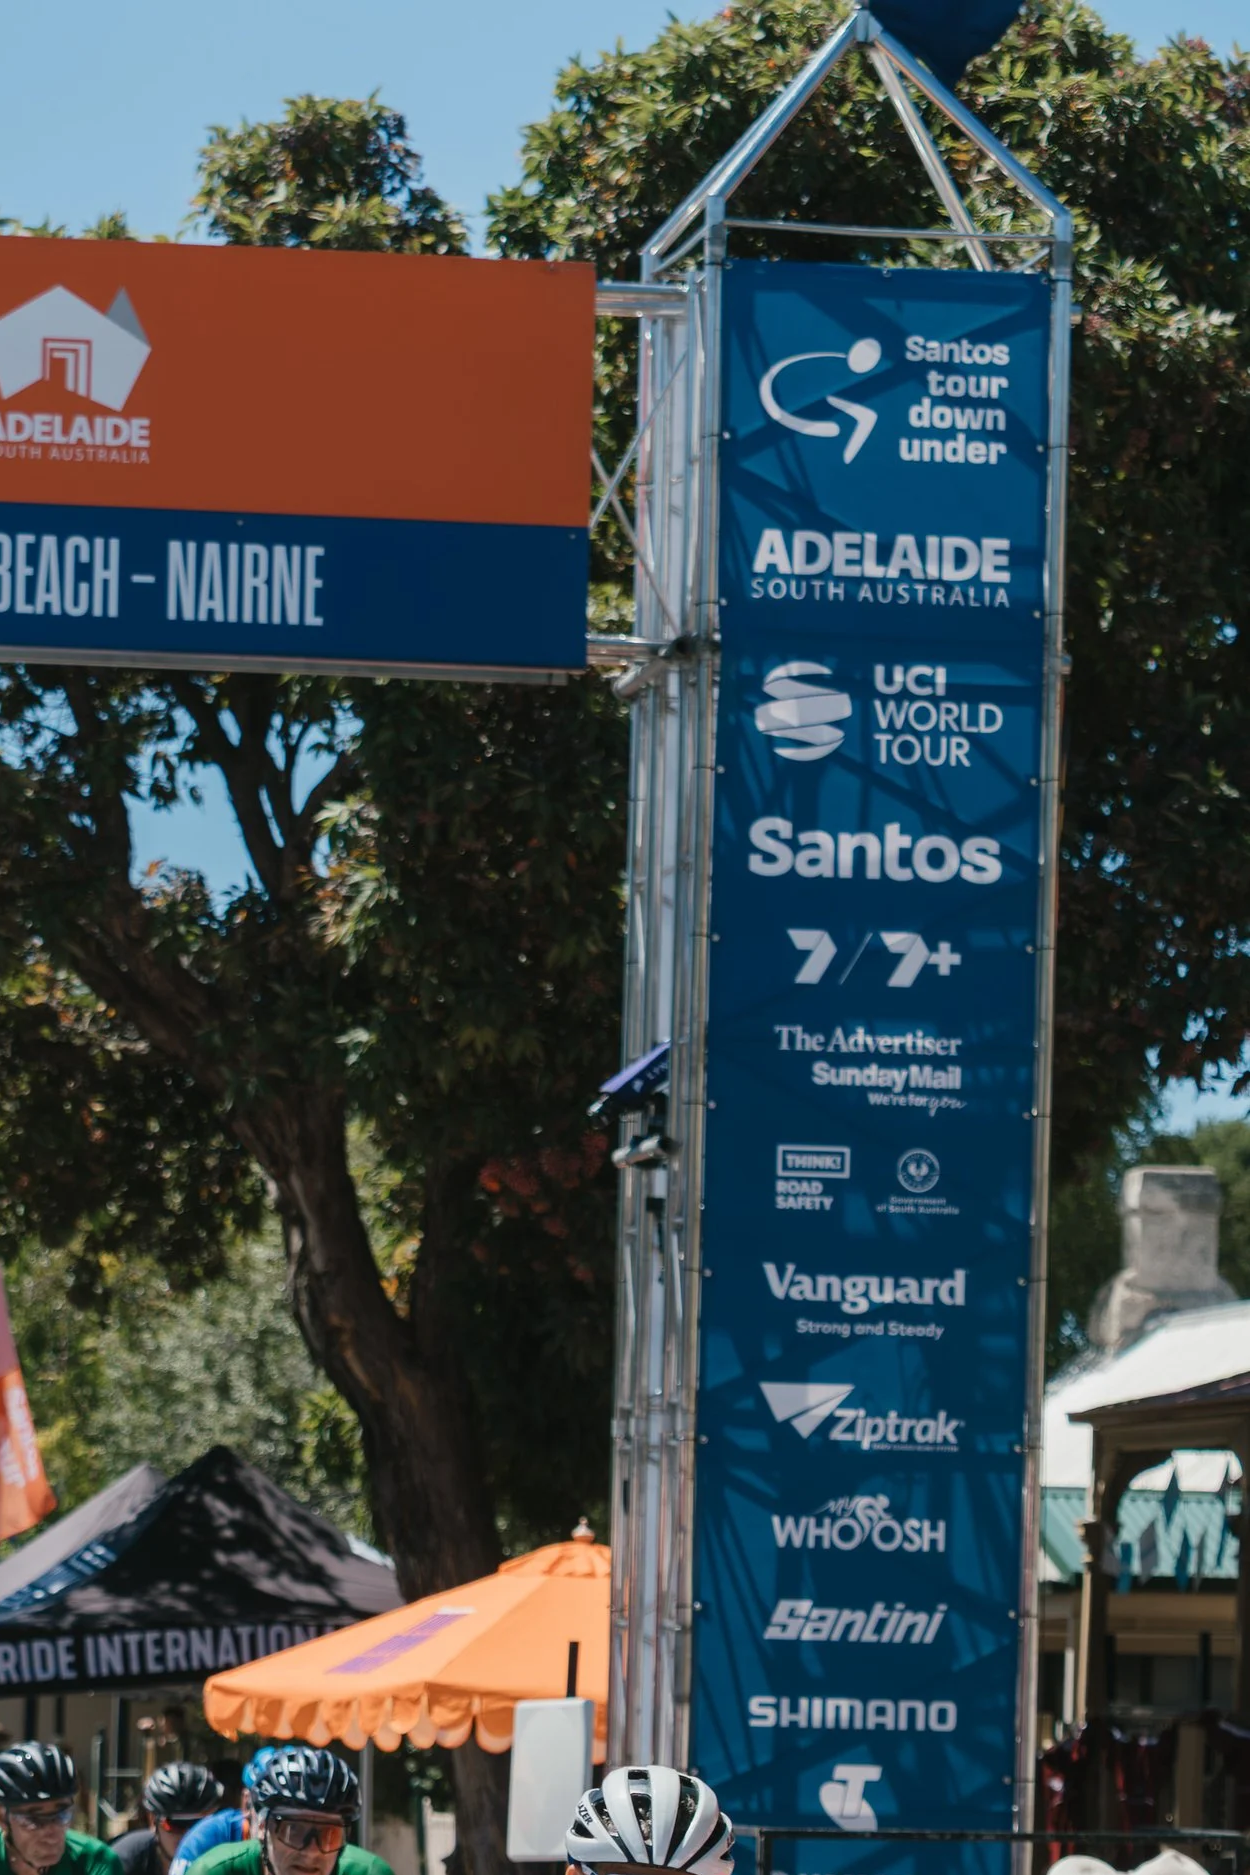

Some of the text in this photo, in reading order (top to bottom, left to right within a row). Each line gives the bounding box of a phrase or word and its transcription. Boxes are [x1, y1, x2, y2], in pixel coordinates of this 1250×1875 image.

[905, 335, 1011, 366] Santos
[927, 369, 1009, 399] tour
[908, 397, 1007, 431] down
[49, 446, 151, 464] AUSTRALIA
[900, 433, 1007, 465] under
[752, 528, 1011, 584] ADELAIDE
[167, 540, 326, 626] NAIRNE
[750, 576, 1011, 608] SOUTH AUSTRALIA
[873, 663, 947, 696] UCI
[873, 698, 1004, 734] WORLD
[873, 733, 972, 768] TOUR
[748, 816, 1003, 885] Santos
[774, 1025, 962, 1057] The Advertiser
[811, 1060, 962, 1093] Sunday Mail
[785, 1153, 842, 1170] THINK!
[775, 1179, 824, 1196] ROAD
[775, 1196, 834, 1211] SAFETY
[762, 1261, 967, 1315] Vanguard
[795, 1318, 945, 1341] Strong and Steady
[828, 1407, 960, 1451] Ziptrak
[771, 1514, 947, 1552] WHOOSH
[763, 1598, 949, 1645] Santini
[85, 1624, 335, 1678] INTERNATIO
[748, 1695, 958, 1733] SHIMANO
